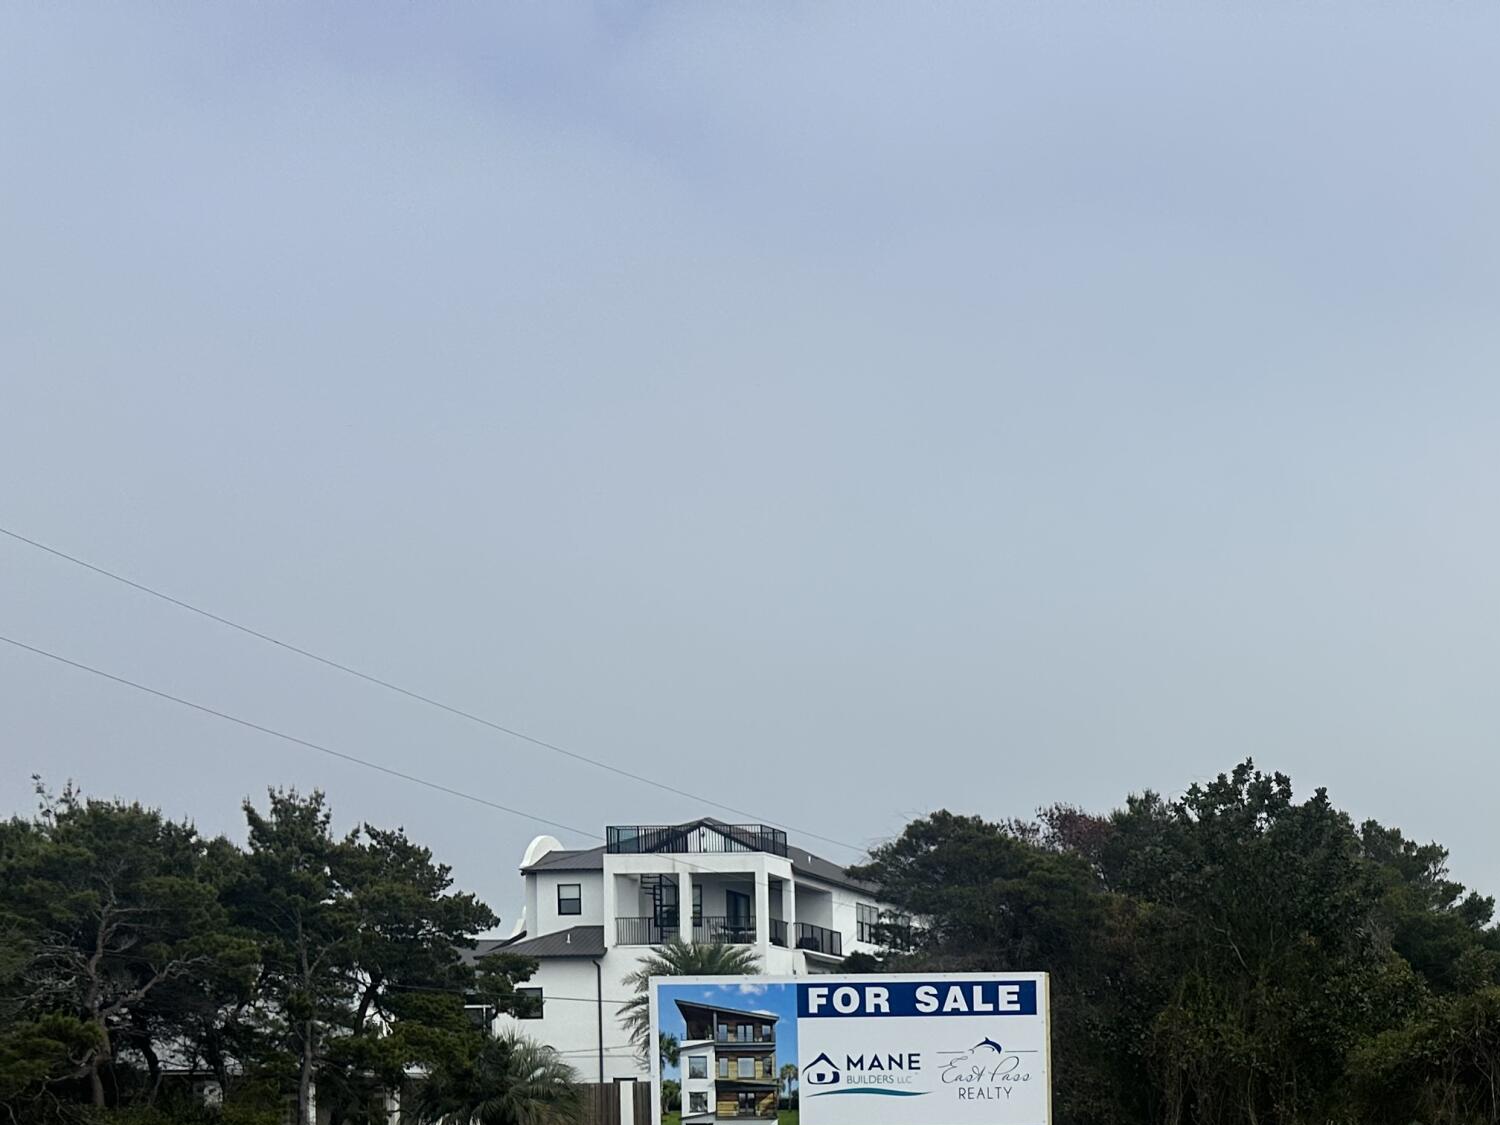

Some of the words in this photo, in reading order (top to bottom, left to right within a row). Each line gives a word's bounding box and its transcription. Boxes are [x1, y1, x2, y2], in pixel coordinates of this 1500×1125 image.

[808, 986, 890, 1014] FOR
[915, 985, 1021, 1013] SALE
[846, 1053, 921, 1071] MANE
[938, 1056, 985, 1083] East
[988, 1056, 1032, 1082] Pass
[846, 1074, 894, 1084] BUILDERS
[897, 1075, 912, 1084] LLC
[959, 1087, 1012, 1099] REALTY
